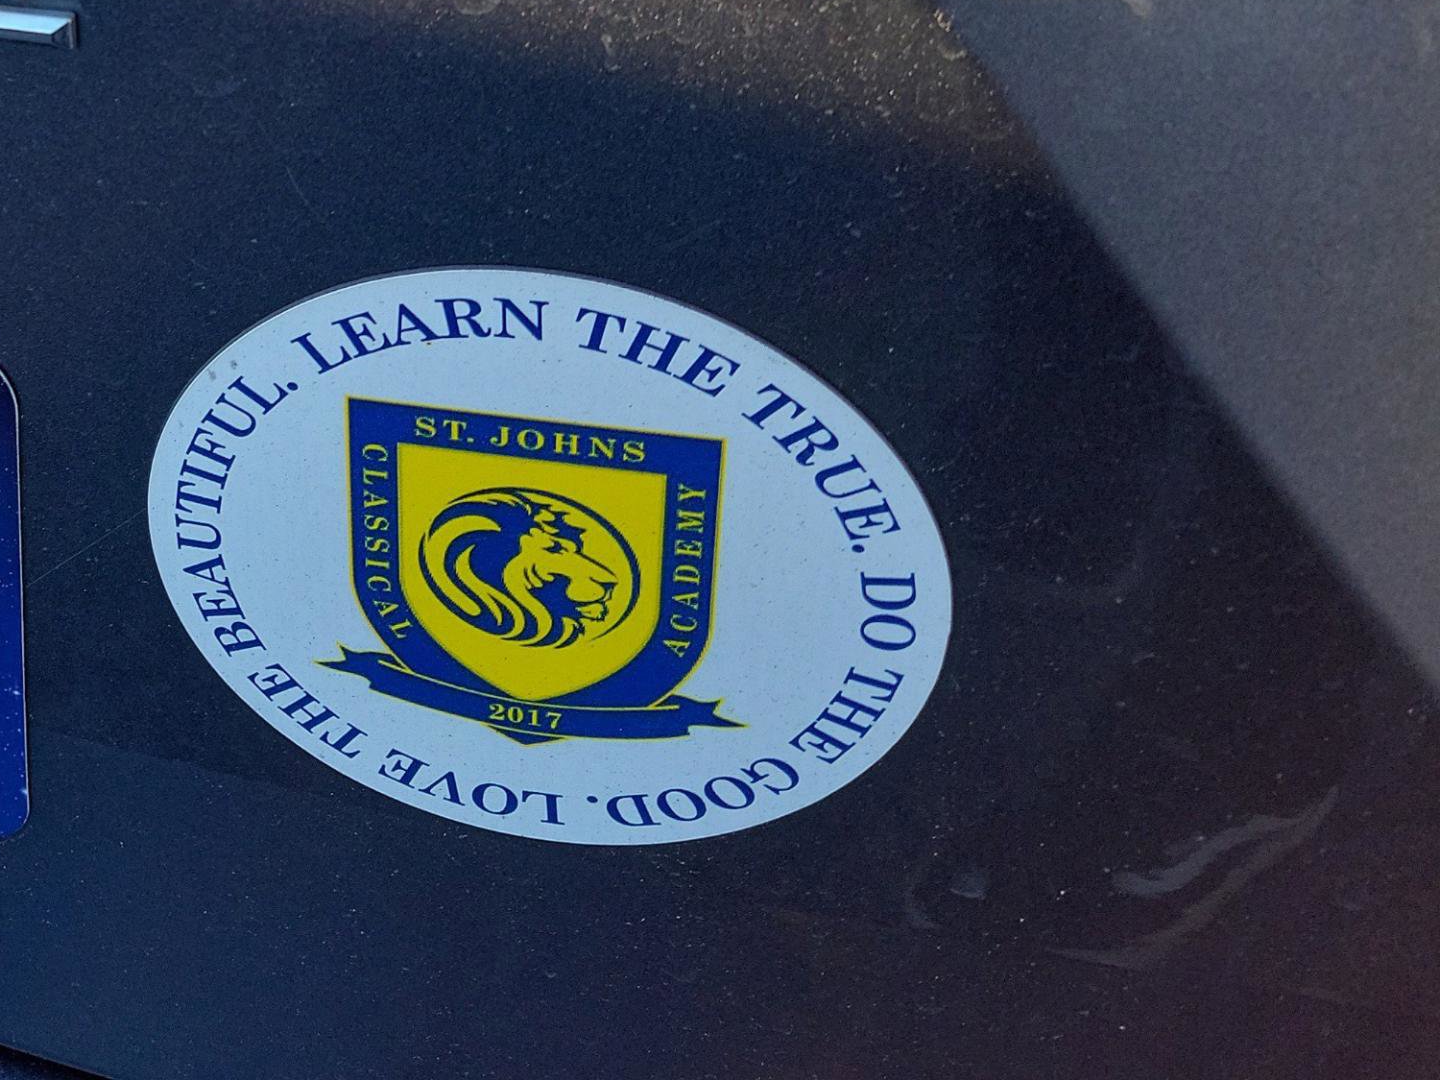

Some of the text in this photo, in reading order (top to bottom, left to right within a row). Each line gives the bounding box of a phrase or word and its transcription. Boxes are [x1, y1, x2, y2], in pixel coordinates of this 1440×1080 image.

[289, 297, 902, 555] LEARN THE TRUE.
[414, 415, 646, 463] ST. JOHNS
[174, 375, 566, 826] LOVE THE BEAUTIFUL.
[361, 442, 416, 640] CLASSICAL
[663, 483, 707, 659] ACADEMY
[488, 702, 563, 730] 2017
[586, 571, 917, 827] DO THE GOOD.
